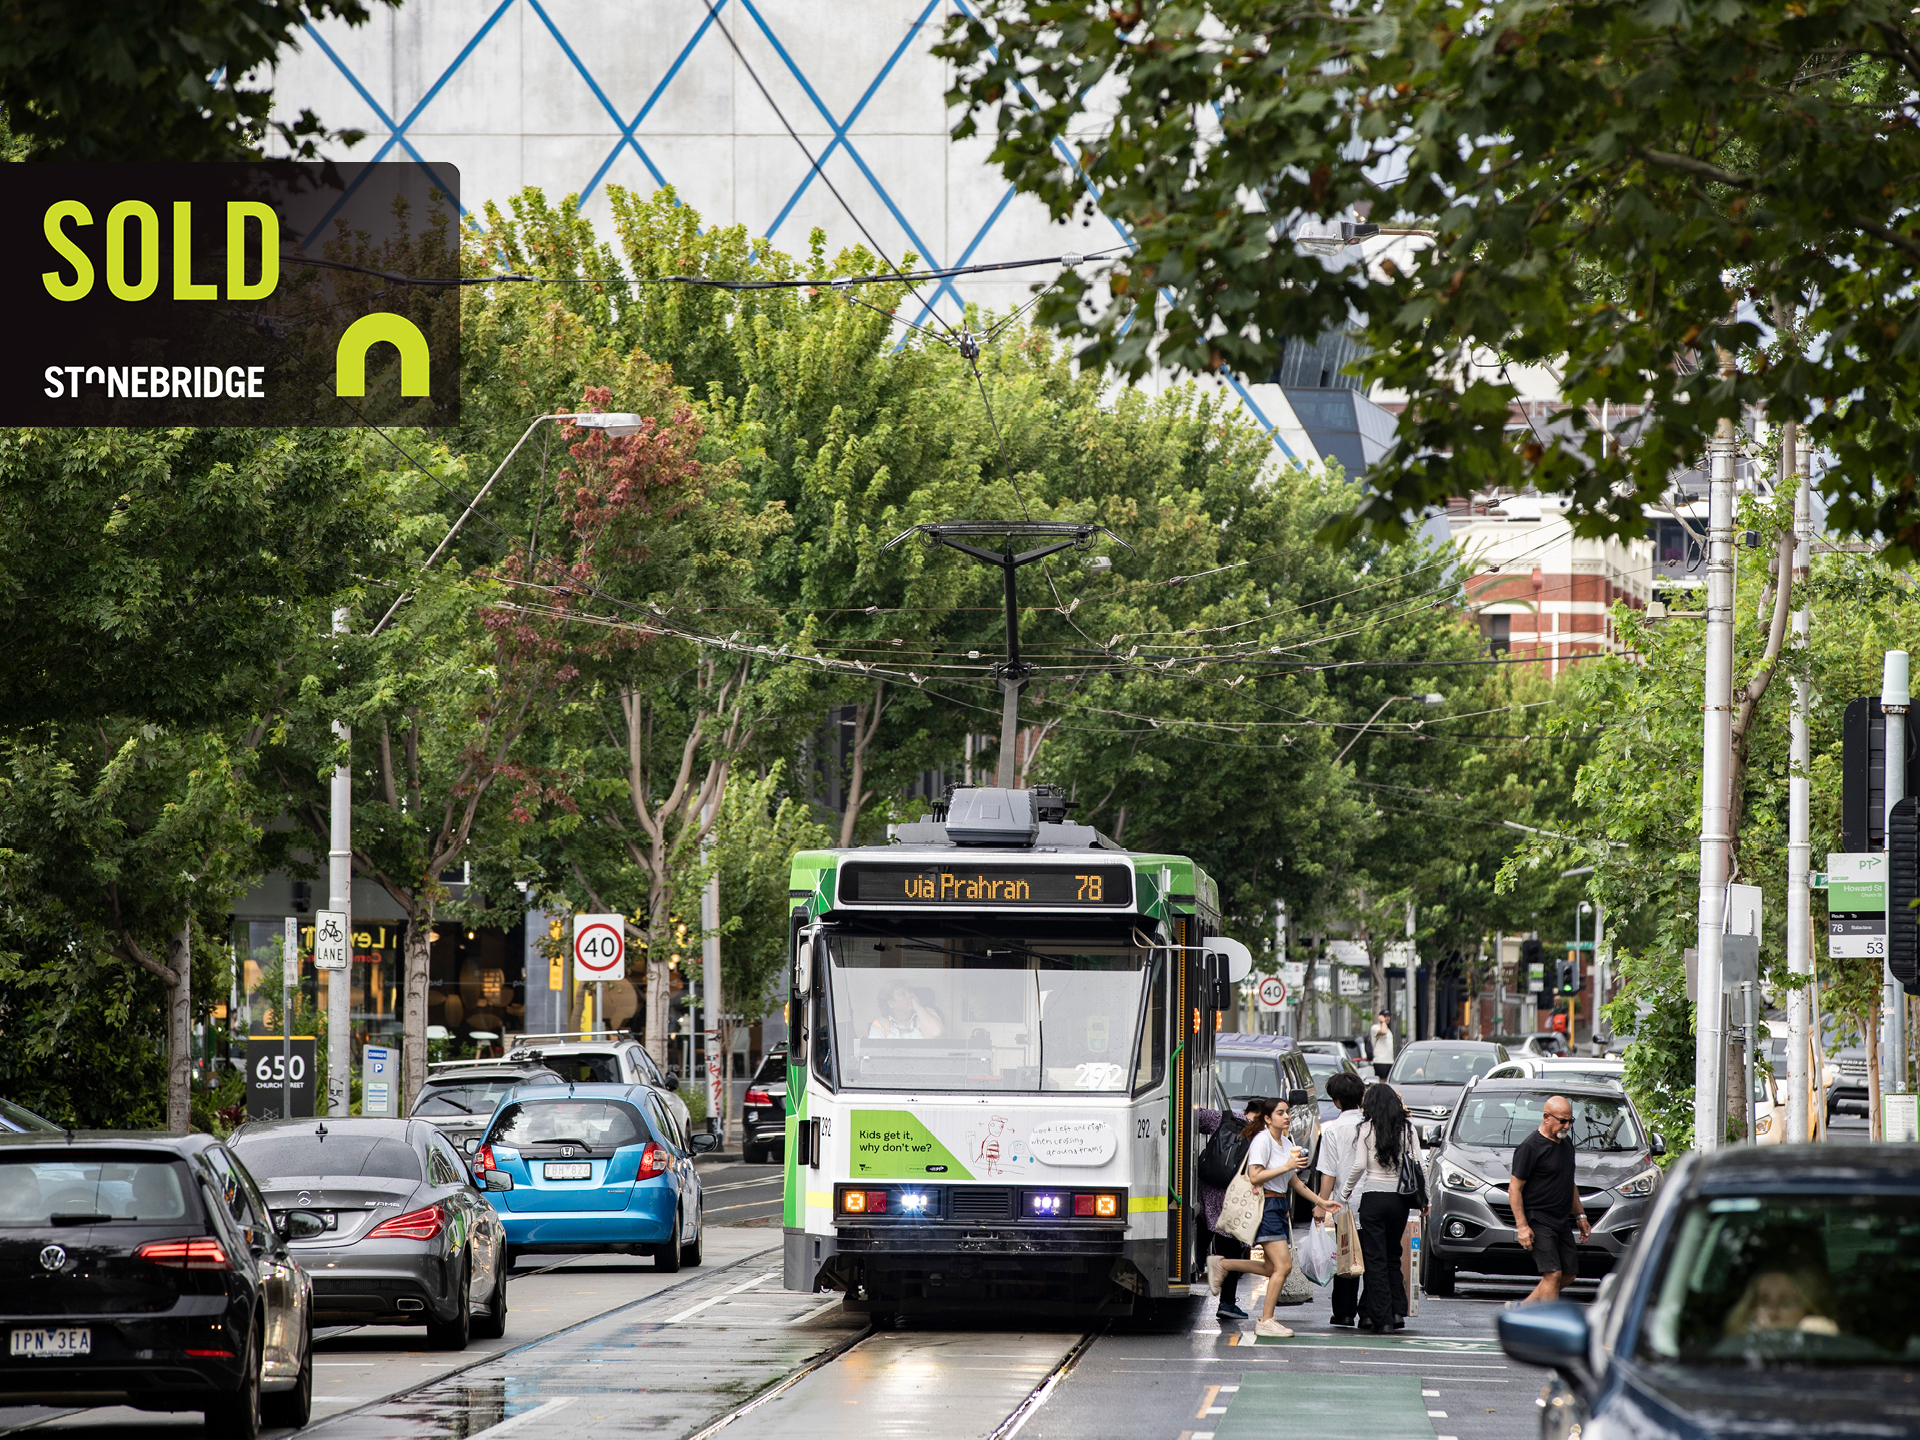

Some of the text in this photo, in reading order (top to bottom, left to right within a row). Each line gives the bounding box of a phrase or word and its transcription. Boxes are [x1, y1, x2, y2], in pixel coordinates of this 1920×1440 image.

[904, 873, 1103, 901] via Prahran 78
[1843, 884, 1883, 892] Howard St
[1831, 923, 1844, 933] 78
[317, 946, 344, 961] LANE
[583, 936, 616, 958] 40
[1866, 942, 1885, 955] 53
[1263, 985, 1282, 998] 40
[255, 1054, 306, 1081] 650
[1074, 1063, 1122, 1090] 292
[255, 1081, 305, 1089] CHURCH REET
[821, 1116, 832, 1137] 292
[1032, 1120, 1106, 1134] Look left and right
[1137, 1118, 1151, 1139] 292
[859, 1130, 914, 1142] Kids get it,
[1030, 1137, 1084, 1146] when crossing
[859, 1142, 932, 1154] why don't we?
[1045, 1144, 1103, 1157] around trams
[545, 1163, 589, 1175] YBH 826
[15, 1331, 89, 1350] 1PN 3EA
